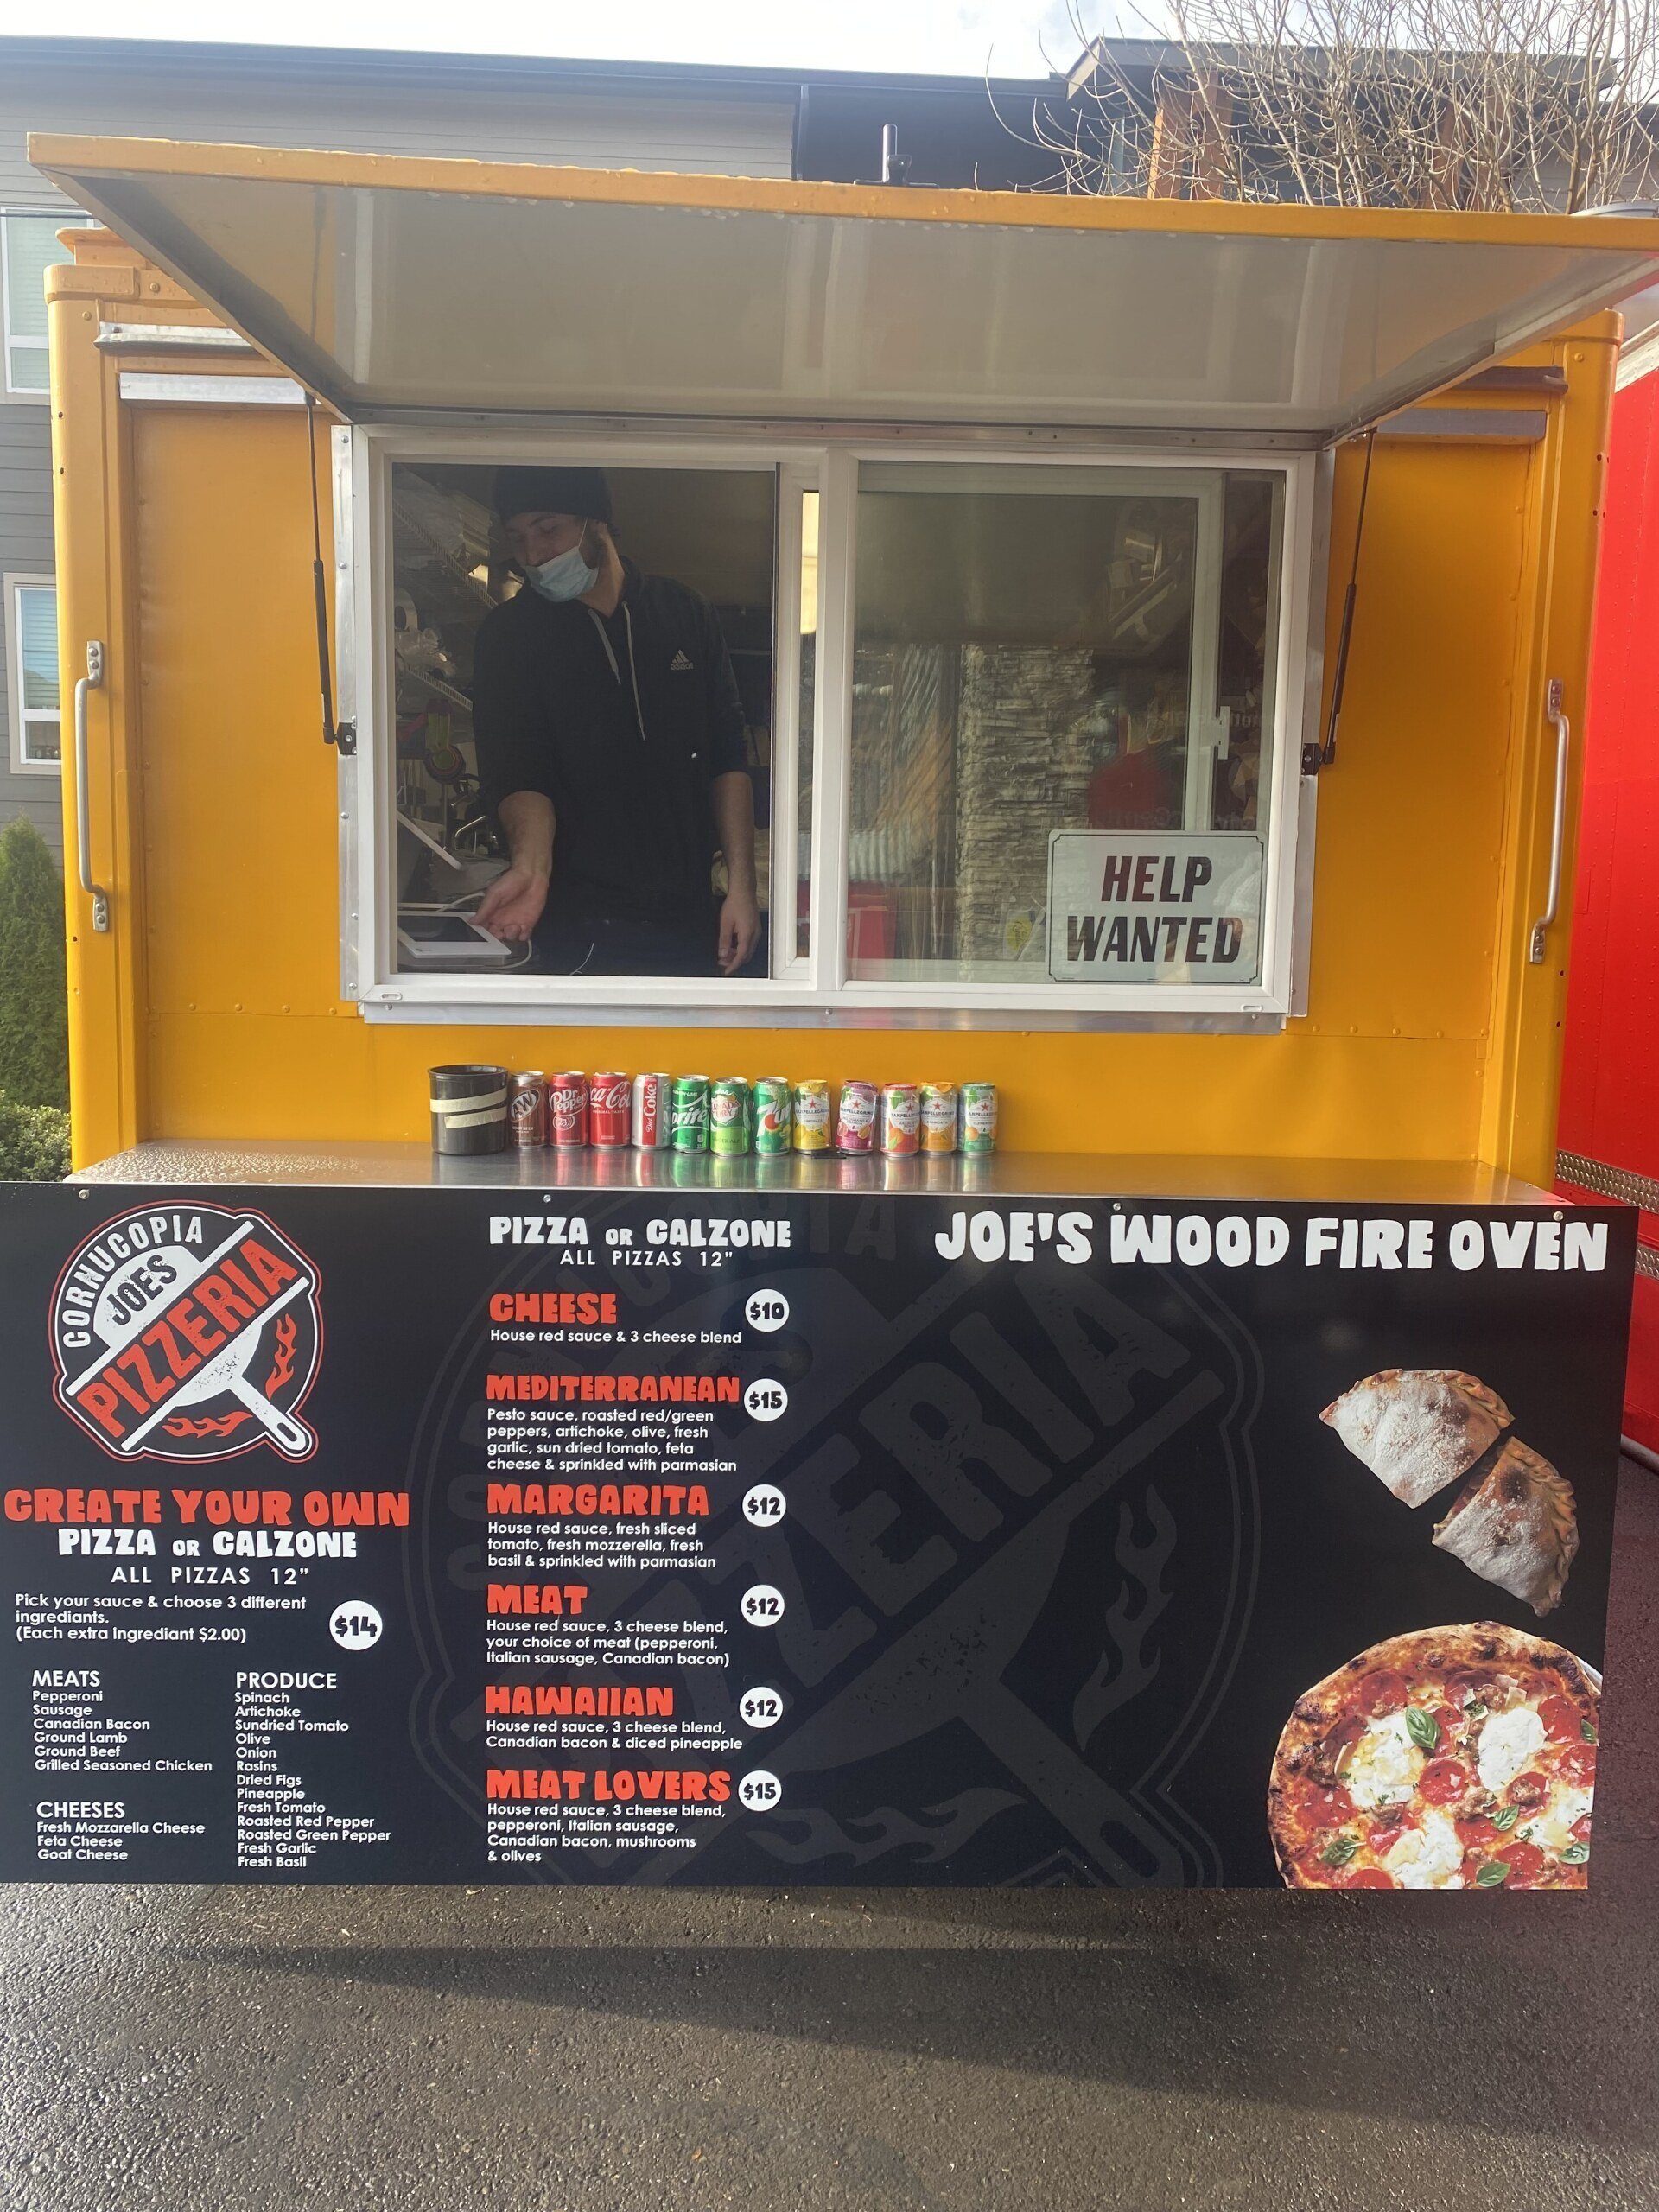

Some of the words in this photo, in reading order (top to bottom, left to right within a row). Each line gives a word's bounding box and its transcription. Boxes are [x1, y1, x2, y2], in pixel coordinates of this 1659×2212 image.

[1101, 855, 1212, 902] HELP
[1067, 916, 1243, 963] WANTED
[552, 1092, 585, 1113] Pepper
[562, 1089, 578, 1101] Dr
[644, 1084, 657, 1116] Coke
[490, 1217, 588, 1245] PIZZA
[605, 1228, 632, 1246] OR
[646, 1219, 791, 1248] CALZONE
[935, 1211, 1093, 1264] JOE'S
[1110, 1214, 1290, 1267] WOOD
[1305, 1217, 1433, 1269] FIRE
[1449, 1219, 1608, 1271] OVEN
[63, 1215, 203, 1348] CORNUCOPIA
[111, 1254, 177, 1325] JOES
[490, 1293, 617, 1325] CHEESE
[750, 1302, 785, 1320] $10
[77, 1239, 298, 1438] PIZZERIA
[491, 1329, 535, 1341] House
[539, 1330, 563, 1341] red
[568, 1332, 612, 1342] sauce
[616, 1331, 626, 1342] &
[631, 1330, 639, 1342] 3
[643, 1330, 696, 1343] cheese
[701, 1331, 741, 1344] blend
[486, 1375, 740, 1402] MEDITERRANEAN
[749, 1391, 784, 1410] $15
[487, 1408, 526, 1421] Pesto
[530, 1411, 578, 1422] sauce,
[582, 1408, 637, 1421] roasted
[640, 1409, 714, 1424] red/green
[487, 1427, 551, 1440] peppers,
[556, 1425, 627, 1439] artichoke,
[632, 1425, 671, 1439] olive,
[674, 1426, 708, 1438] fresh
[487, 1441, 532, 1456] garlic,
[537, 1444, 561, 1453] sun
[565, 1441, 602, 1453] dried
[606, 1442, 662, 1455] tomato,
[665, 1442, 694, 1454] feta
[487, 1458, 541, 1470] cheese
[545, 1459, 555, 1470] &
[559, 1458, 624, 1472] sprinkled
[627, 1458, 657, 1471] with
[661, 1459, 736, 1473] parmasian
[4, 1488, 162, 1524] CREATE
[171, 1489, 292, 1526] YOUR
[304, 1491, 410, 1527] OWN
[487, 1484, 709, 1516] MARGARITA
[747, 1497, 781, 1516] $12
[488, 1522, 532, 1534] House
[536, 1522, 560, 1534] red
[564, 1525, 612, 1535] sauce,
[616, 1522, 650, 1535] fresh
[654, 1522, 696, 1535] sliced
[58, 1528, 156, 1556] PIZZA
[173, 1540, 200, 1556] OR
[213, 1530, 357, 1558] CALZONE
[487, 1538, 543, 1552] tomato,
[547, 1538, 581, 1550] fresh
[585, 1539, 665, 1552] mozzerella,
[670, 1539, 703, 1551] fresh
[111, 1567, 152, 1583] ALL
[171, 1567, 250, 1585] PIZZAS
[16, 1593, 49, 1606] Pick
[53, 1597, 90, 1610] your
[93, 1597, 143, 1607] sauce
[148, 1595, 158, 1608] &
[163, 1595, 223, 1608] choose
[227, 1596, 237, 1608] 3
[241, 1596, 307, 1609] different
[487, 1584, 588, 1615] MEAT
[746, 1597, 779, 1617] $12
[16, 1610, 109, 1625] ingrediants.
[334, 1615, 378, 1637] $14
[487, 1619, 531, 1631] House
[534, 1619, 558, 1631] red
[563, 1623, 610, 1633] sauce,
[614, 1620, 622, 1632] 3
[626, 1620, 679, 1632] cheese
[683, 1620, 728, 1634] blend,
[16, 1626, 63, 1642] (Each
[67, 1626, 108, 1640] extra
[112, 1626, 194, 1643] ingrediant
[199, 1627, 246, 1643] $2.00)
[486, 1638, 518, 1649] your
[522, 1636, 572, 1648] choice
[575, 1636, 590, 1648] of
[594, 1637, 632, 1648] meat
[634, 1637, 718, 1651] (pepperoni,
[32, 1670, 100, 1687] MEATS
[237, 1672, 337, 1689] PRODUCE
[33, 1690, 103, 1704] Pepperoni
[234, 1692, 289, 1705] Spinach
[486, 1686, 673, 1716] HAWAIIAN
[33, 1704, 92, 1718] Sausage
[235, 1706, 301, 1717] Artichoke
[745, 1699, 778, 1718] $12
[33, 1718, 102, 1729] Canadian
[106, 1719, 150, 1730] Bacon
[235, 1719, 295, 1731] Sundried
[298, 1719, 349, 1732] Tomato
[235, 1732, 271, 1745] Olive
[486, 1736, 556, 1748] Canadian
[561, 1736, 607, 1748] bacon
[612, 1738, 621, 1748] &
[626, 1737, 666, 1749] diced
[671, 1737, 743, 1751] pineapple
[35, 1745, 86, 1757] Ground
[90, 1745, 121, 1757] Beef
[236, 1746, 276, 1758] Onion
[35, 1758, 79, 1770] Grilled
[83, 1759, 151, 1770] Seasoned
[155, 1760, 213, 1771] Chicken
[237, 1760, 277, 1771] Rasins
[237, 1774, 272, 1785] Dried
[276, 1774, 302, 1788] Figs
[486, 1769, 586, 1800] MEAT
[594, 1770, 731, 1802] LOVERS
[237, 1788, 305, 1802] Pineapple
[743, 1782, 776, 1801] $15
[36, 1801, 125, 1819] CHEESES
[37, 1821, 72, 1833] Fresh
[75, 1821, 149, 1834] Mozzarella
[152, 1822, 206, 1834] Cheese
[238, 1815, 292, 1827] Roasted
[296, 1815, 321, 1827] Red
[326, 1816, 375, 1829] Pepper
[487, 1819, 564, 1834] pepperoni,
[569, 1819, 612, 1832] Italian
[616, 1822, 678, 1834] sausage,
[37, 1835, 67, 1847] Feta
[70, 1835, 123, 1847] Cheese
[238, 1842, 272, 1853] Fresh
[276, 1842, 316, 1853] Garlic
[37, 1848, 73, 1859] Goat
[75, 1848, 129, 1860] Cheese
[238, 1856, 272, 1867] Fresh
[276, 1856, 307, 1867] Basil
[487, 1850, 497, 1861] &
[501, 1850, 542, 1862] olives
